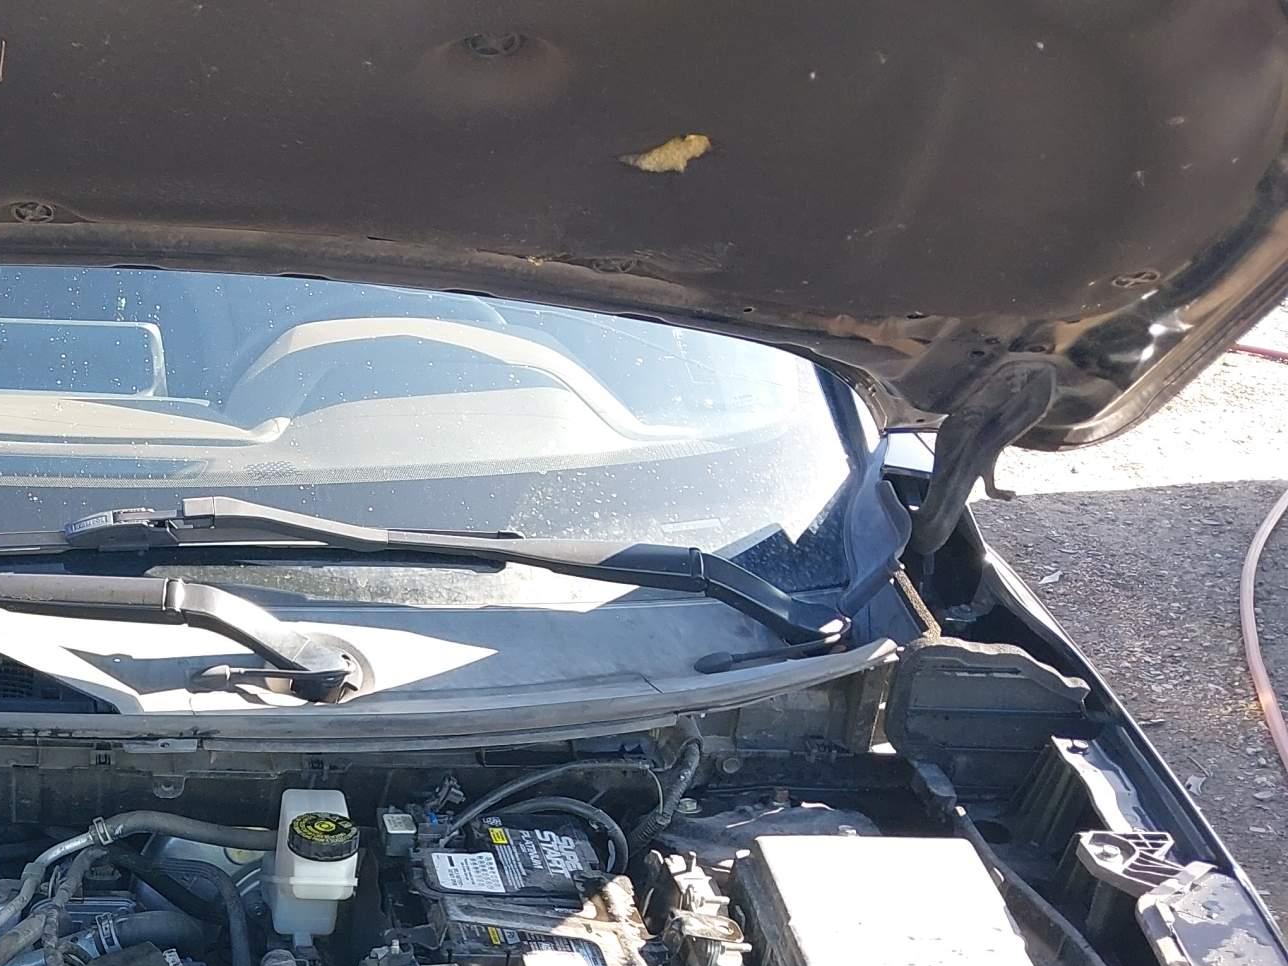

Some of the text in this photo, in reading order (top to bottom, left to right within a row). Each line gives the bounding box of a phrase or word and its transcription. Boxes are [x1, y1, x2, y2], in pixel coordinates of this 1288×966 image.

[519, 830, 544, 869] PLATINUM
[534, 829, 571, 879] START
[556, 835, 584, 871] SUPE
